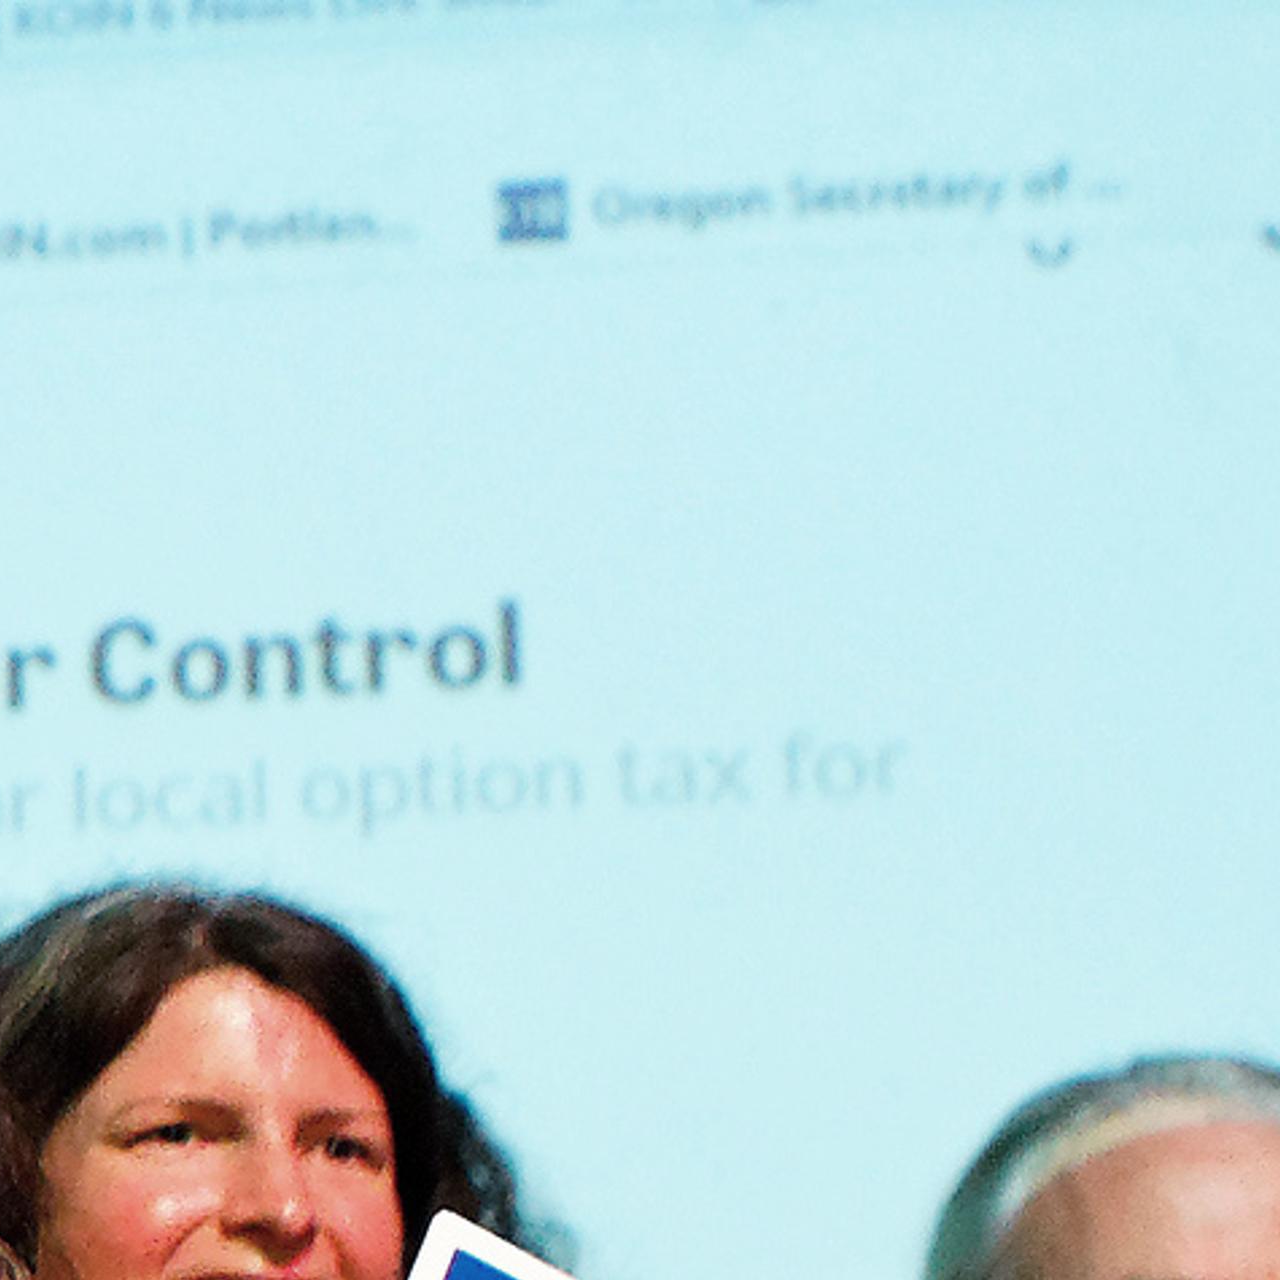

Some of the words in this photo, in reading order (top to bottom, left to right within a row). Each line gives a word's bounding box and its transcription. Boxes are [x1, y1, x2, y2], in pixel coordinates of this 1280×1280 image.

[90, 598, 524, 704] Control
[71, 760, 270, 834] local
[300, 740, 585, 837] option
[617, 743, 753, 810] tax
[782, 727, 906, 800] for
